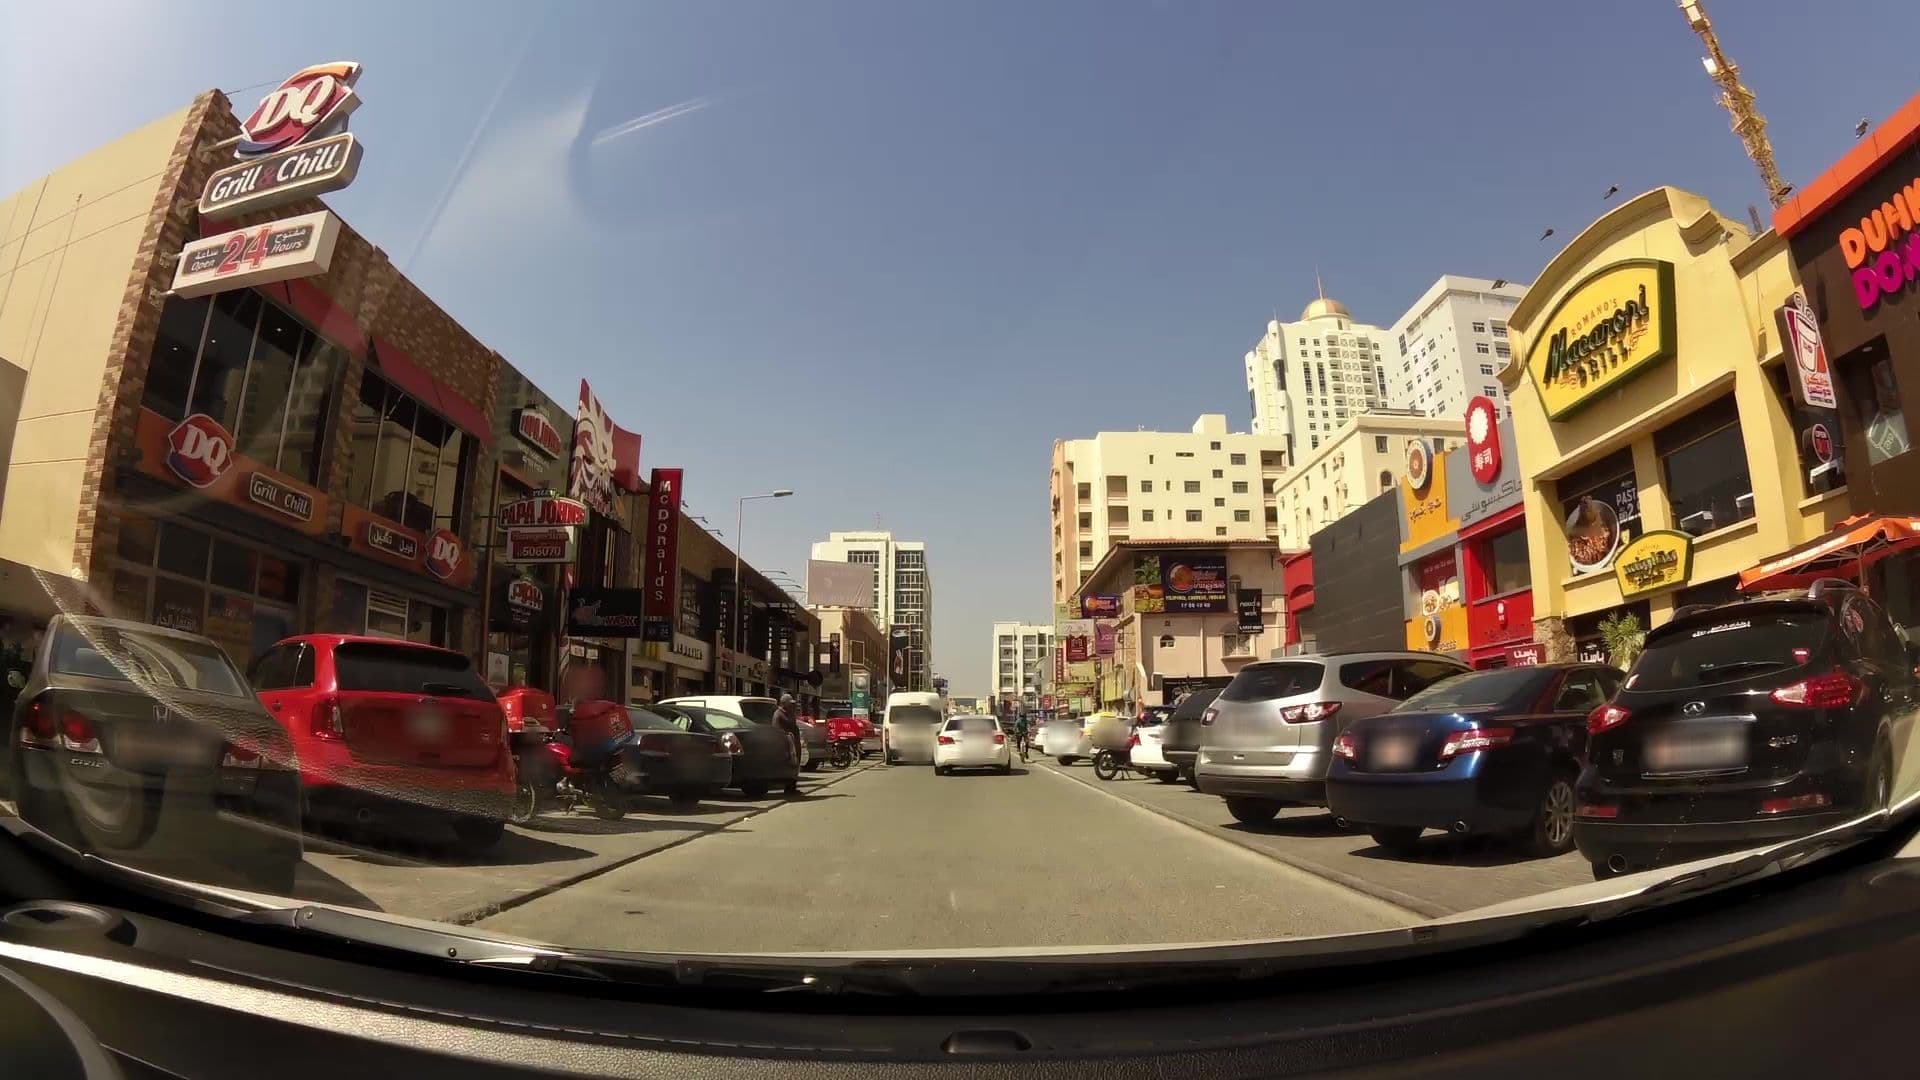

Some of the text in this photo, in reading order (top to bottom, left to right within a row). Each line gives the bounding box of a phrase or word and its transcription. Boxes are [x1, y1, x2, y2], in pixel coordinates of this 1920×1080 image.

[253, 75, 336, 133] DQ
[210, 164, 263, 202] Grill
[276, 143, 340, 182] Chill
[190, 224, 305, 277] Open 24 Hours
[1543, 283, 1650, 385] Macaroni
[178, 423, 229, 477] DQ
[252, 480, 310, 515] Grill Chill
[432, 535, 460, 570] DQ
[654, 479, 673, 603] McDonald's
